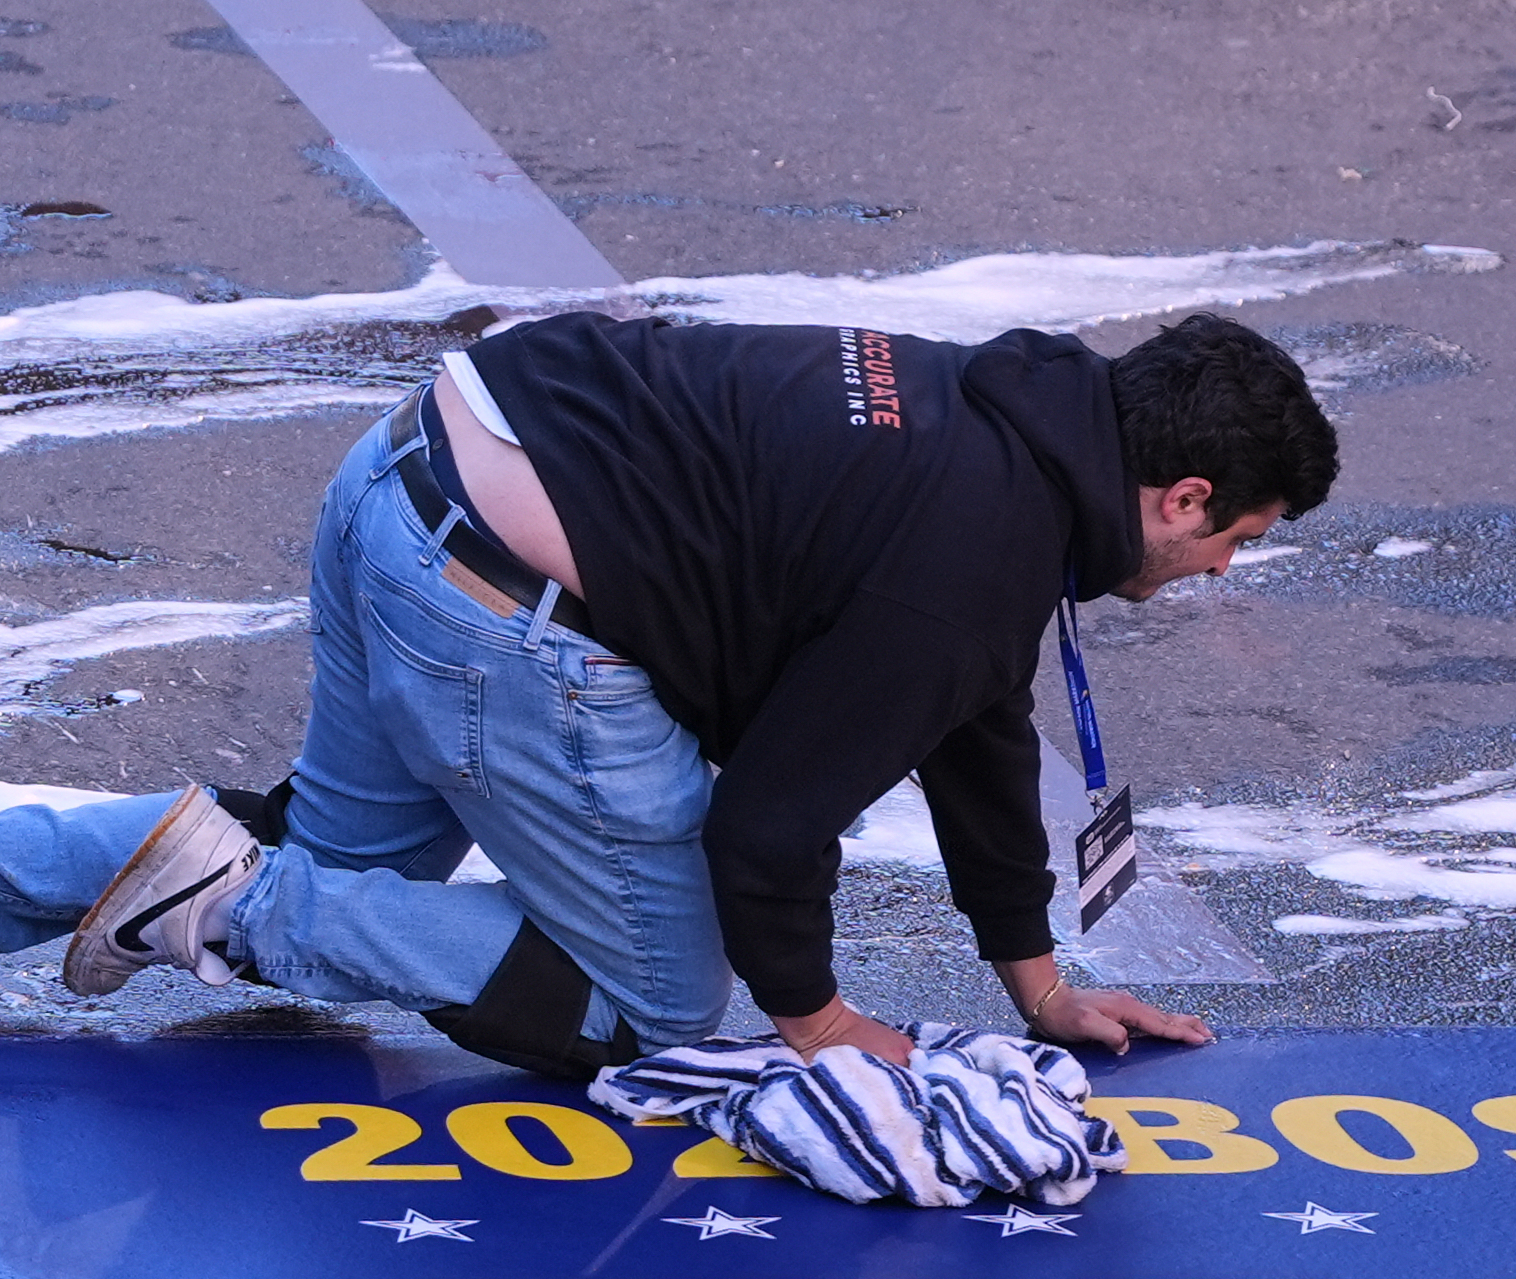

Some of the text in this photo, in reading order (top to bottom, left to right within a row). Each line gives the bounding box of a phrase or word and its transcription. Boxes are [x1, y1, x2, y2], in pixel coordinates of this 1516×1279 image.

[847, 391, 867, 426] INC
[861, 329, 901, 429] ACCURATE
[260, 1102, 785, 1181] 20
